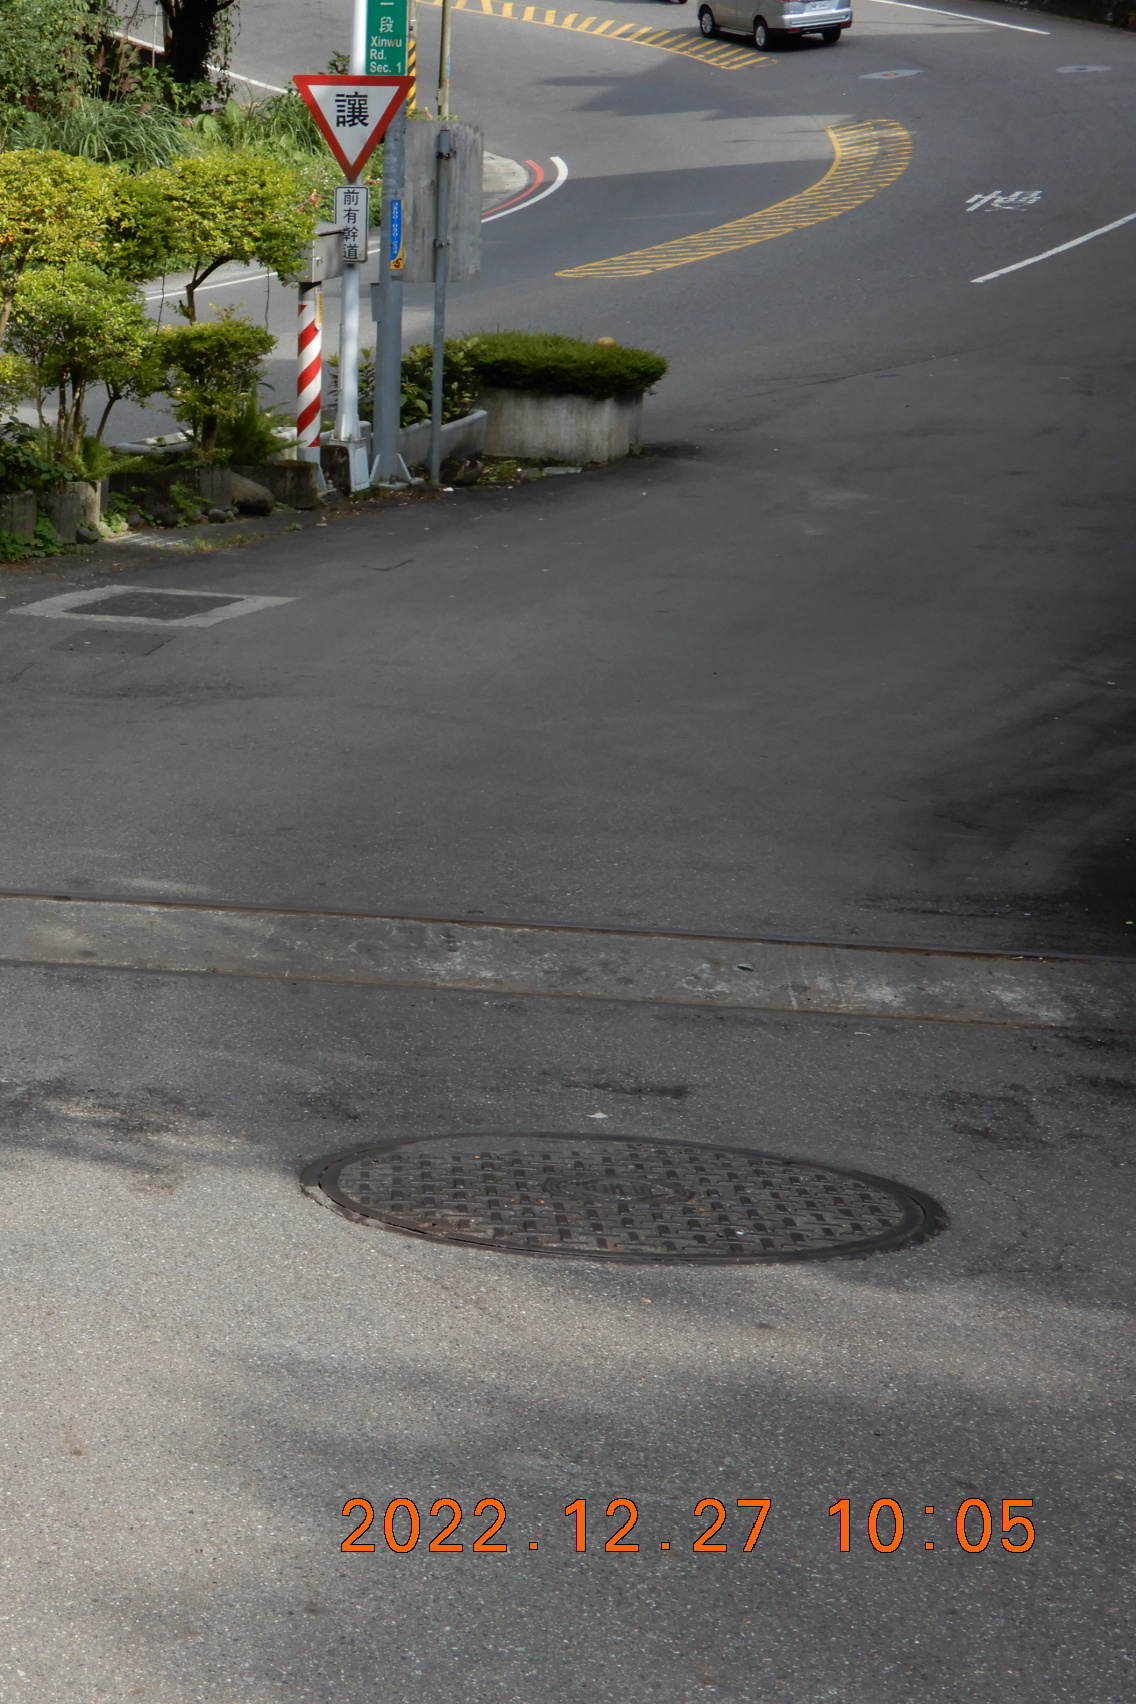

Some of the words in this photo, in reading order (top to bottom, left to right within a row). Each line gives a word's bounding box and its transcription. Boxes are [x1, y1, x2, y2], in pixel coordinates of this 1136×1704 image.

[370, 36, 402, 48] Xinwu
[369, 49, 387, 60] Rd.
[369, 62, 392, 73] Sec.
[396, 62, 402, 73] 1
[335, 91, 370, 128] 讓
[343, 189, 360, 260] 前有幹道
